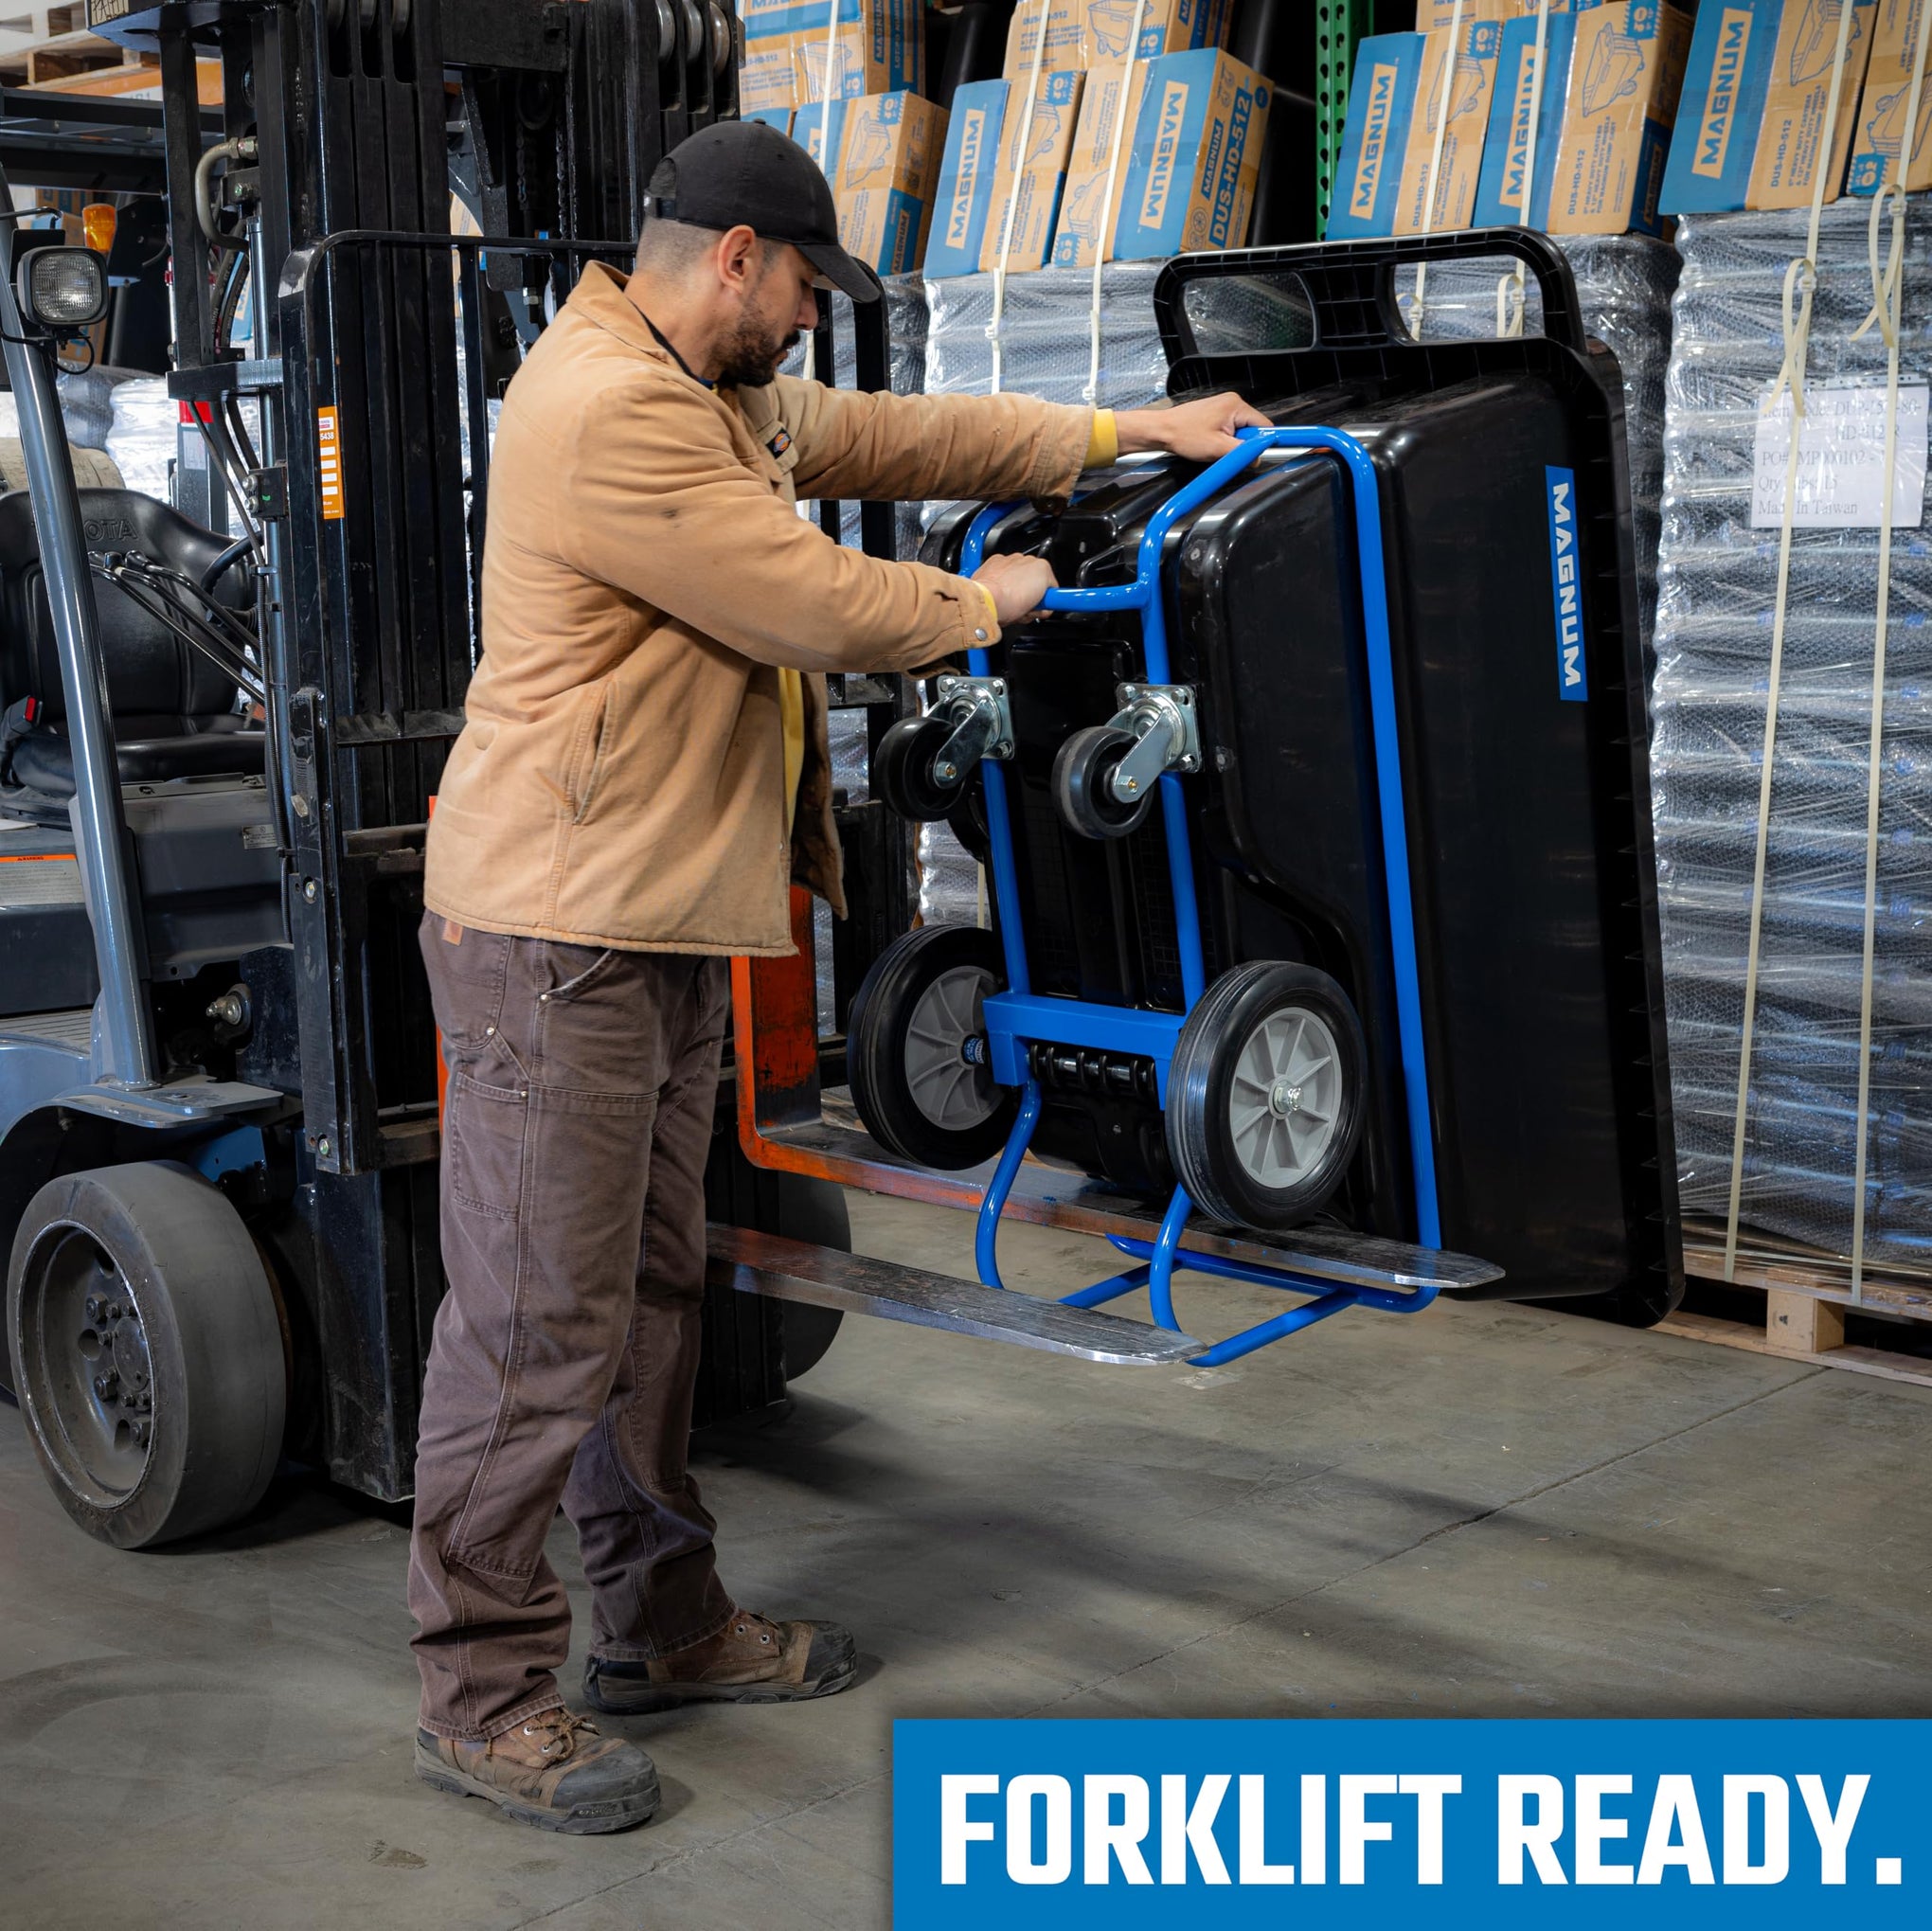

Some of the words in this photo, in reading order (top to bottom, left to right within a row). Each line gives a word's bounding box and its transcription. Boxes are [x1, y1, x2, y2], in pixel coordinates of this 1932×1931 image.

[1356, 75, 1391, 208] MAGNUM
[1701, 21, 1745, 166] MAGNUM
[1770, 118, 1791, 188] DUS-HD-512
[952, 118, 980, 239] MAGNUM
[1146, 92, 1183, 218] MAGNUM
[1203, 124, 1223, 193] MAGNUM
[1212, 96, 1250, 242] DUS-HD-512
[1411, 163, 1430, 226] DUS-HD-512
[1565, 149, 1586, 215] DUS-HD-512
[1797, 500, 1809, 514] In
[1552, 482, 1582, 687] MAGNUM
